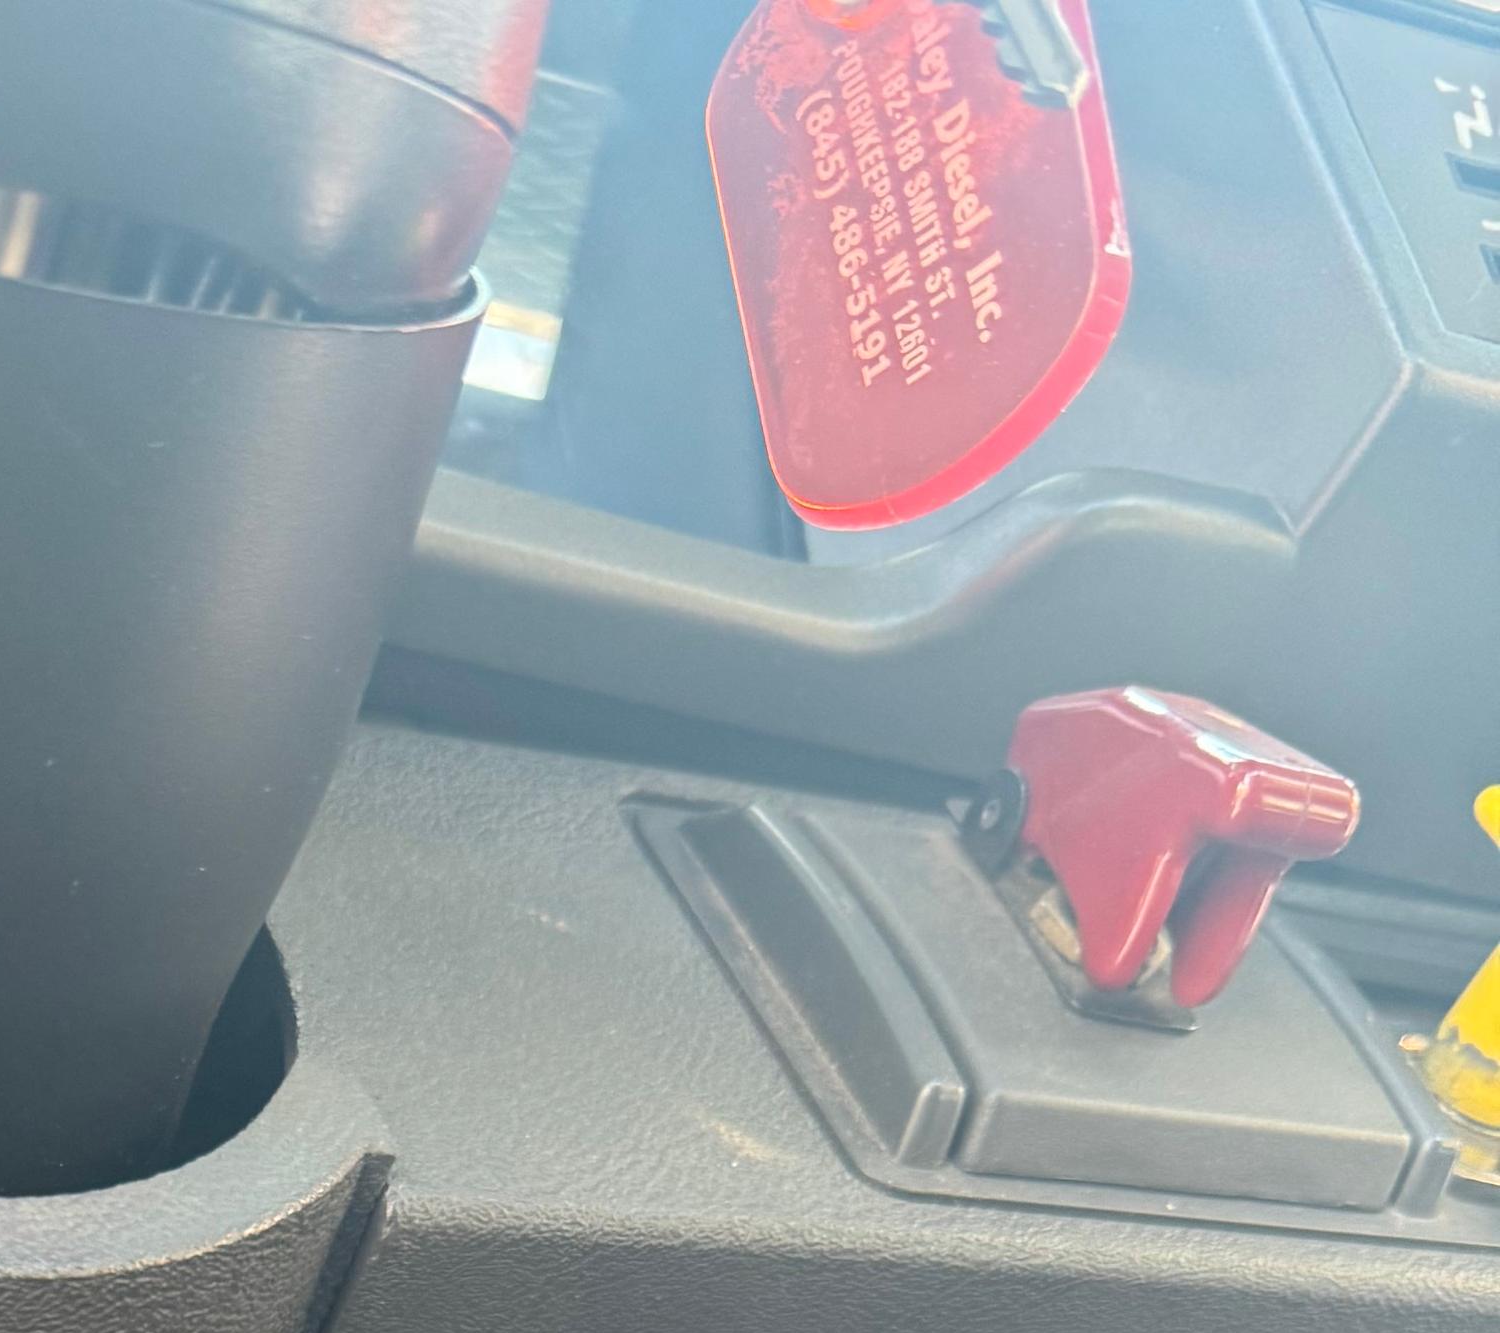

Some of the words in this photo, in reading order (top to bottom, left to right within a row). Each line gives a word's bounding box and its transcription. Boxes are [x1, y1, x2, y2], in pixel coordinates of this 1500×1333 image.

[795, 89, 850, 199] (845)
[828, 204, 892, 387] 486-5191
[903, 170, 948, 268] SMITH
[932, 98, 993, 249] Diesel,
[966, 250, 1003, 343] Inc.
[881, 250, 914, 295] NY
[924, 266, 956, 320] ST.
[892, 299, 932, 385] 12601
